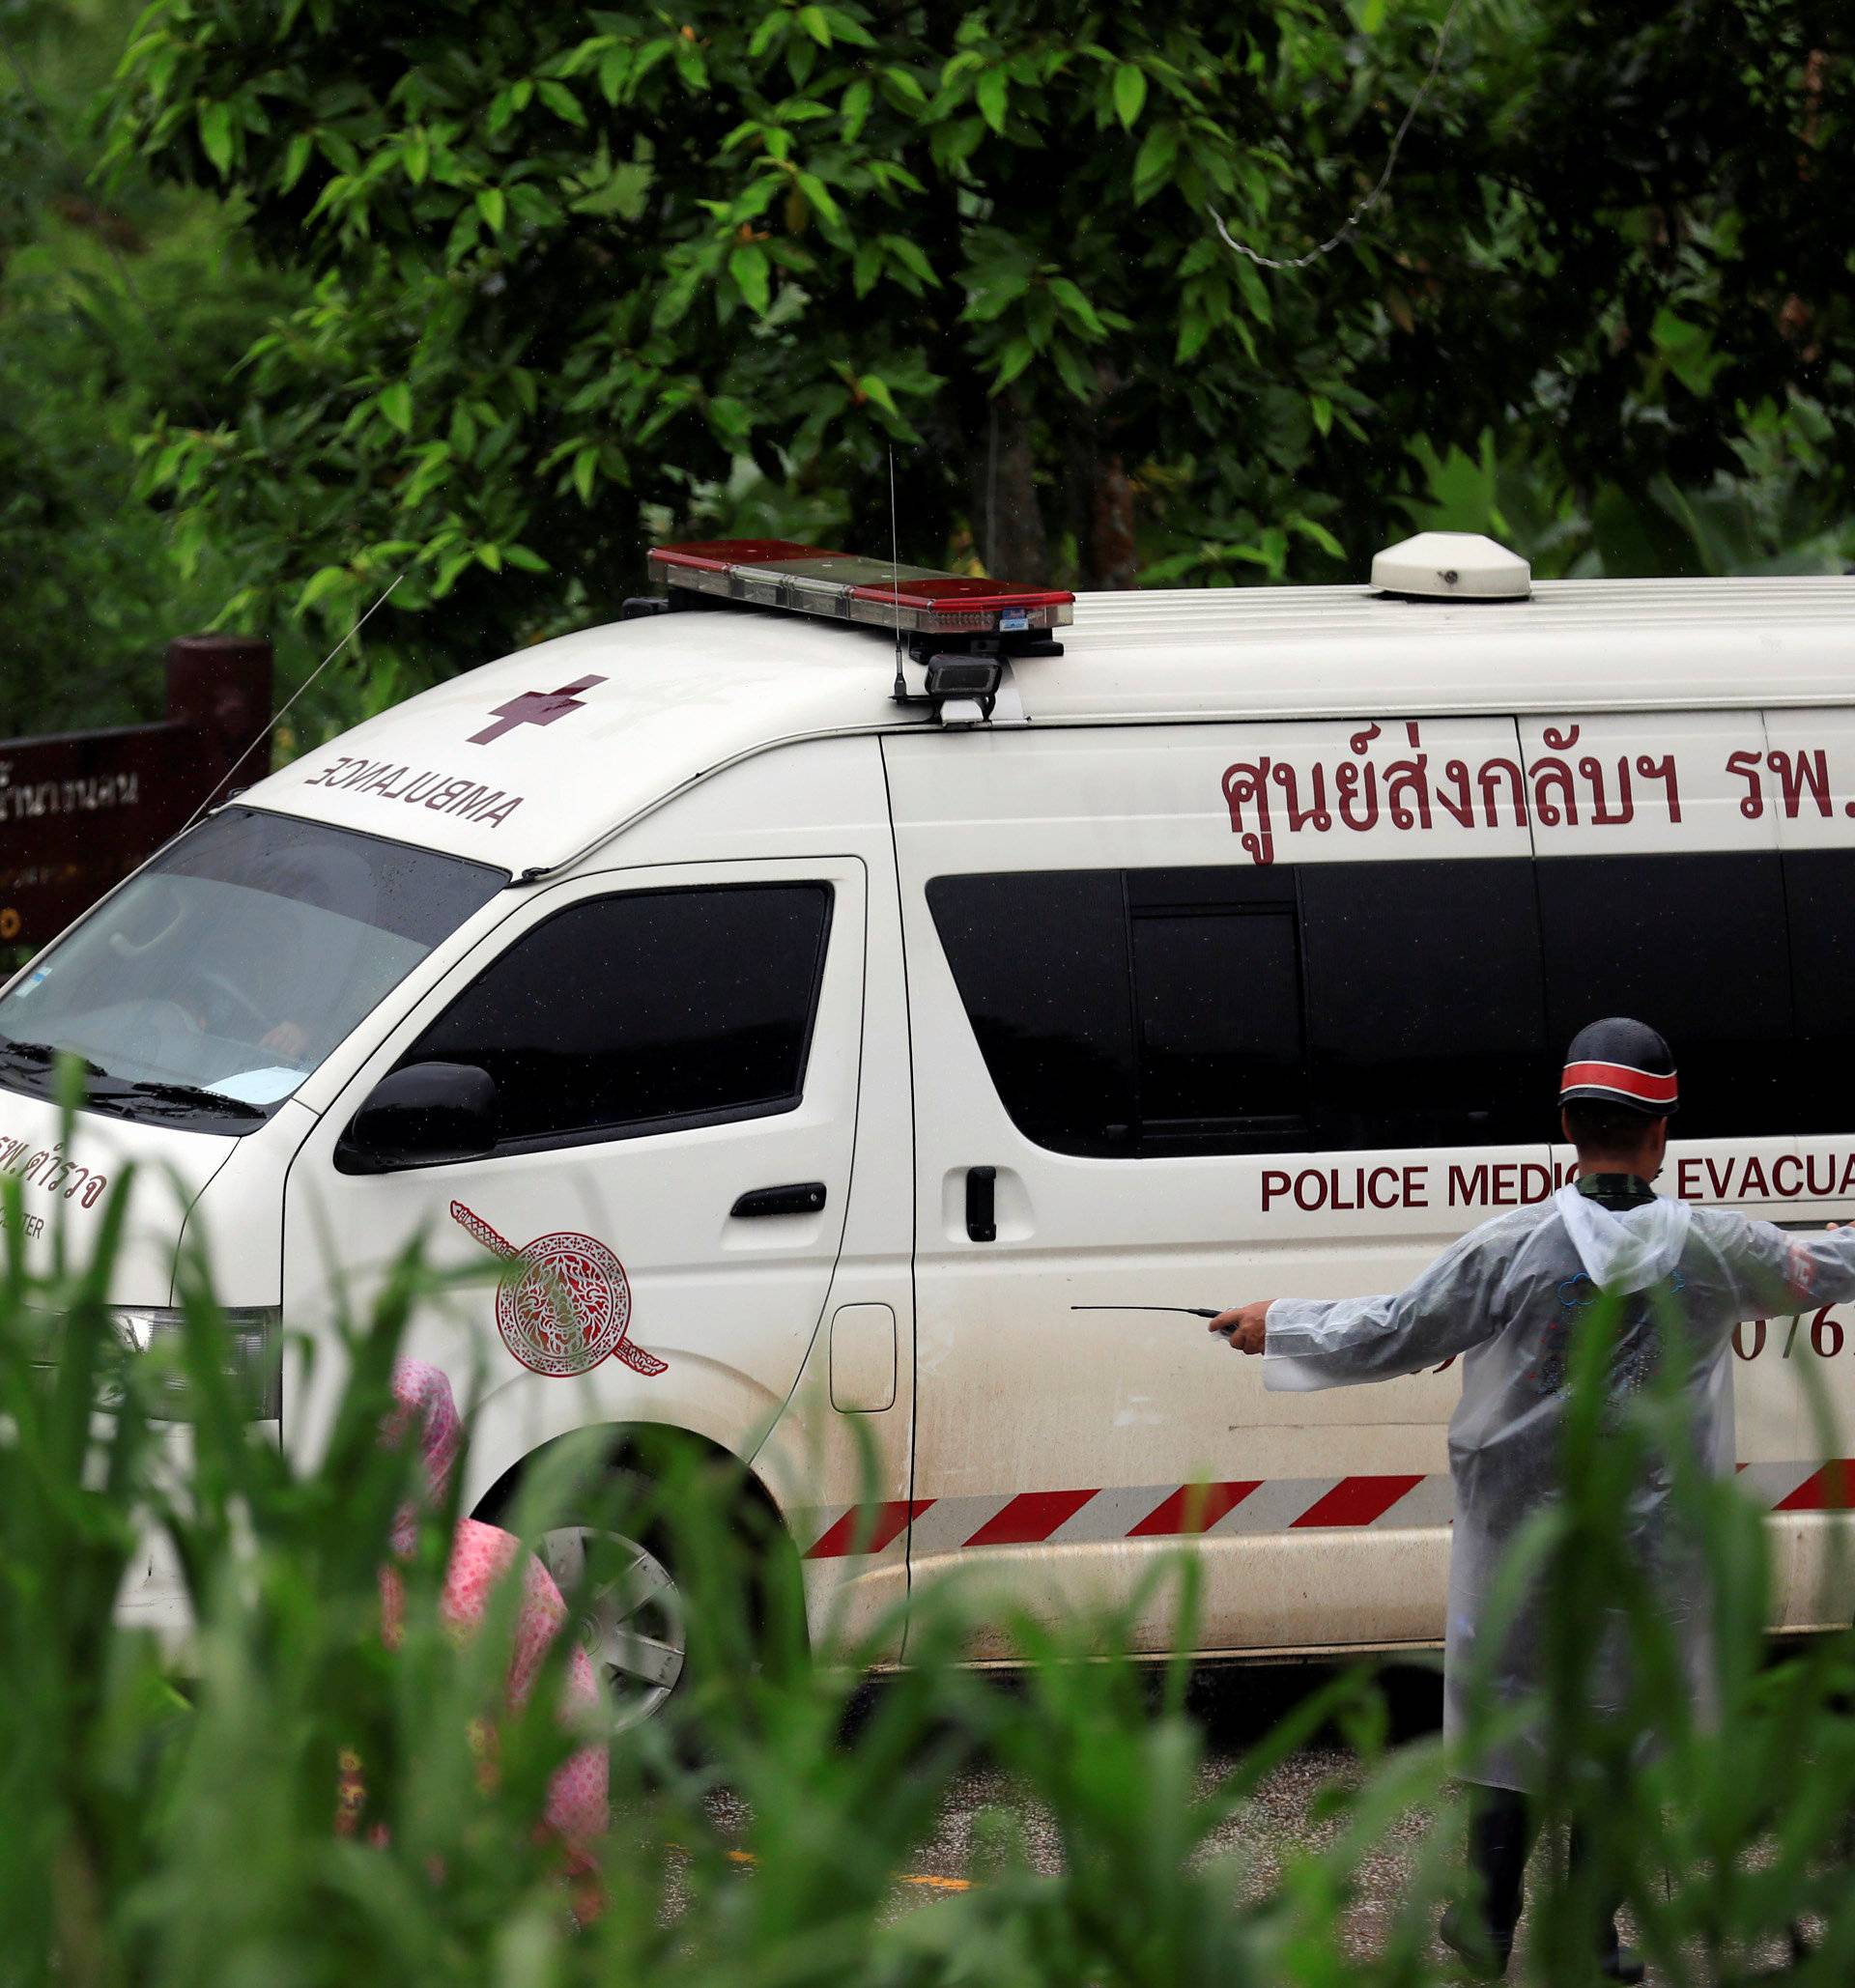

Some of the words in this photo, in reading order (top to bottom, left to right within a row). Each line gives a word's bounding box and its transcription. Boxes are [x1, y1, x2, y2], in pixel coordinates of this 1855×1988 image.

[1221, 722, 1682, 865] ศูนย์ส่งกลับฯ
[1726, 749, 1855, 819] รพ.
[1261, 1166, 1428, 1211] POLICE
[1448, 1161, 1581, 1207] MEDI
